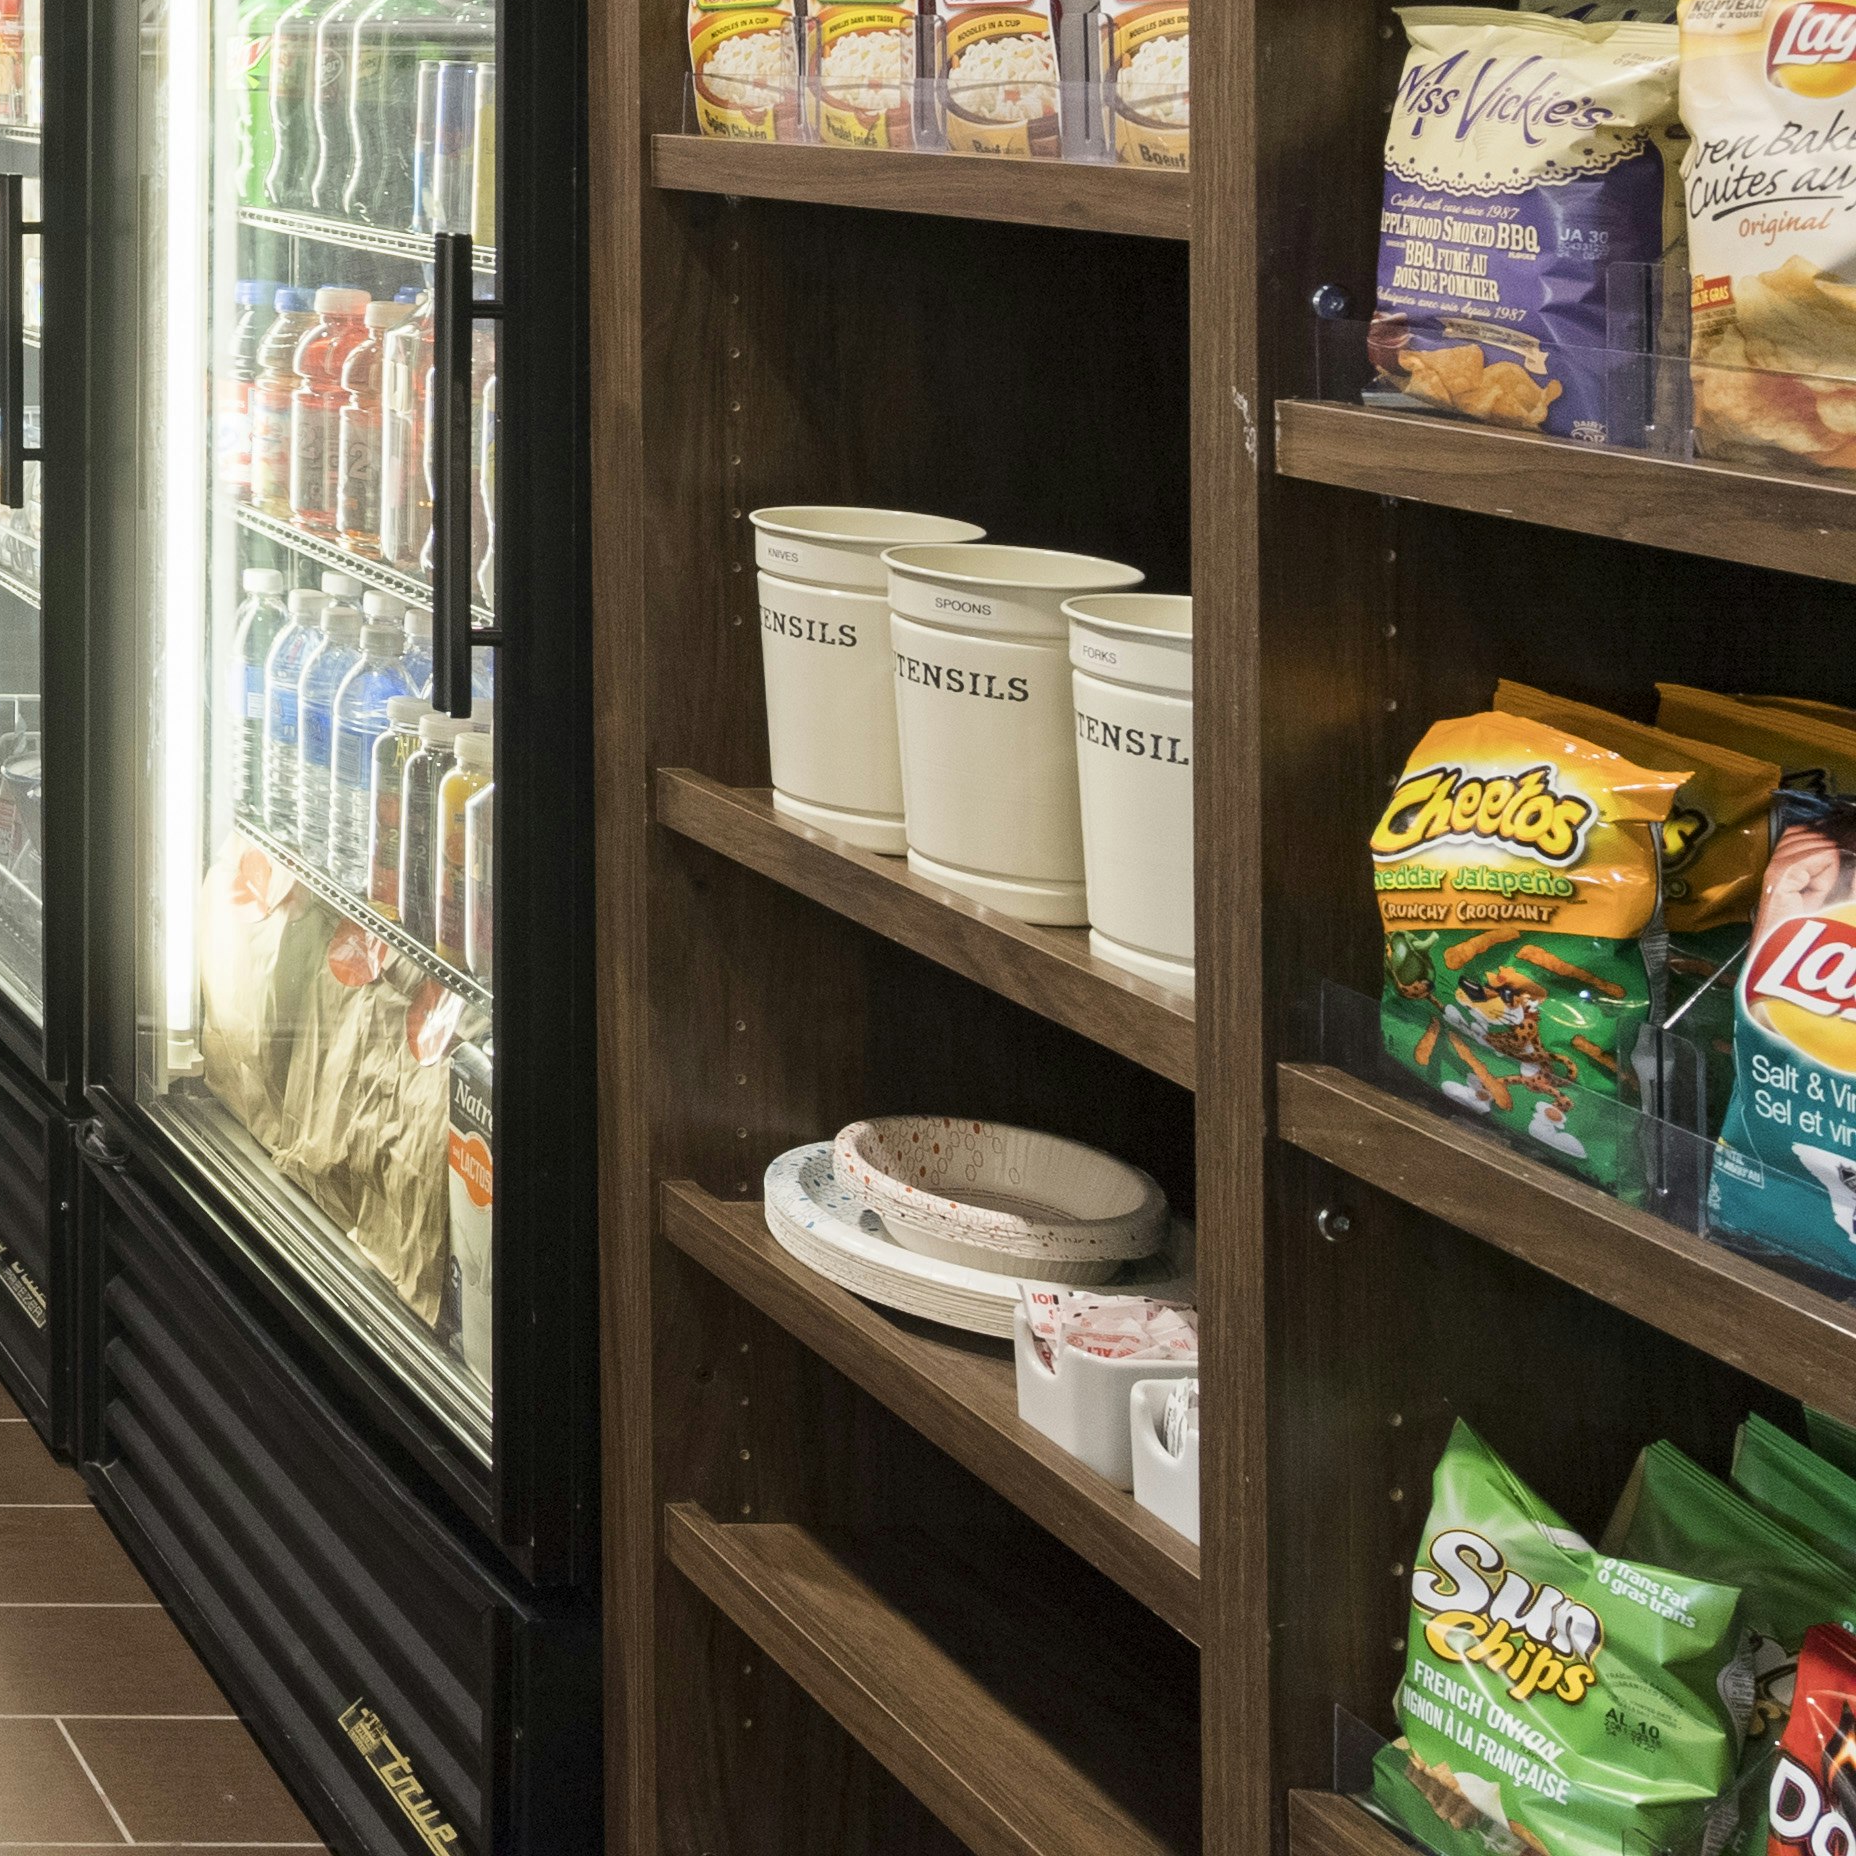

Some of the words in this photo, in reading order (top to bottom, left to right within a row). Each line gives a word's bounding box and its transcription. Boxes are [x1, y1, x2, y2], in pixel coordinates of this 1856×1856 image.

[710, 21, 738, 39] NOODLES
[740, 19, 747, 27] IN
[755, 17, 769, 25] CUP
[850, 16, 863, 24] DANS
[957, 24, 986, 42] NOODLES
[988, 22, 996, 30] IN
[1005, 19, 1021, 28] CUP
[1128, 21, 1157, 40] NOUILLES
[1159, 17, 1175, 27] DANS
[1397, 49, 1470, 139] Miss
[1454, 54, 1614, 147] Vickie's
[1139, 143, 1186, 167] Boeuf
[1688, 168, 1788, 219] Cuites
[1486, 205, 1520, 221] 1987
[1738, 207, 1834, 246] Original
[1442, 216, 1495, 247] SMOKED
[1496, 222, 1541, 253] BBQ
[1559, 228, 1583, 242] JA
[1589, 230, 1609, 243] 30
[1405, 240, 1435, 269] BBQ
[1437, 247, 1471, 273] FUMÉ
[1472, 253, 1488, 276] AU
[1392, 265, 1420, 291] BOIS
[1421, 271, 1439, 293] DE
[1439, 273, 1500, 303] POMMIER
[1493, 307, 1527, 322] 1987
[767, 547, 799, 564] KNIVES
[934, 596, 993, 617] SPOONS
[1082, 645, 1117, 664] FORKS
[1372, 766, 1590, 857] Cheetos
[1452, 866, 1573, 898] Jalapeño
[1382, 901, 1449, 921] CRUNCHY
[1456, 901, 1553, 924] CROQUANT
[1752, 1054, 1797, 1091] Salt
[1806, 1077, 1824, 1097] &
[1756, 1090, 1791, 1125] Sel
[1798, 1110, 1823, 1135] et
[1412, 1529, 1604, 1666] Sun
[1597, 1569, 1609, 1584] 0
[1610, 1577, 1649, 1607] gras
[1651, 1597, 1697, 1629] trans
[1603, 1557, 1616, 1571] 0
[1616, 1561, 1657, 1596] Trans
[1660, 1584, 1690, 1611] Fat
[1424, 1609, 1596, 1704] Chips
[1414, 1659, 1484, 1720] FRENCH
[1487, 1702, 1563, 1766] ONION
[1605, 1707, 1630, 1725] AL
[1636, 1721, 1660, 1741] 10
[1443, 1705, 1456, 1737] À
[1456, 1720, 1476, 1746] LA
[1476, 1729, 1570, 1806] FRANÇAISE
